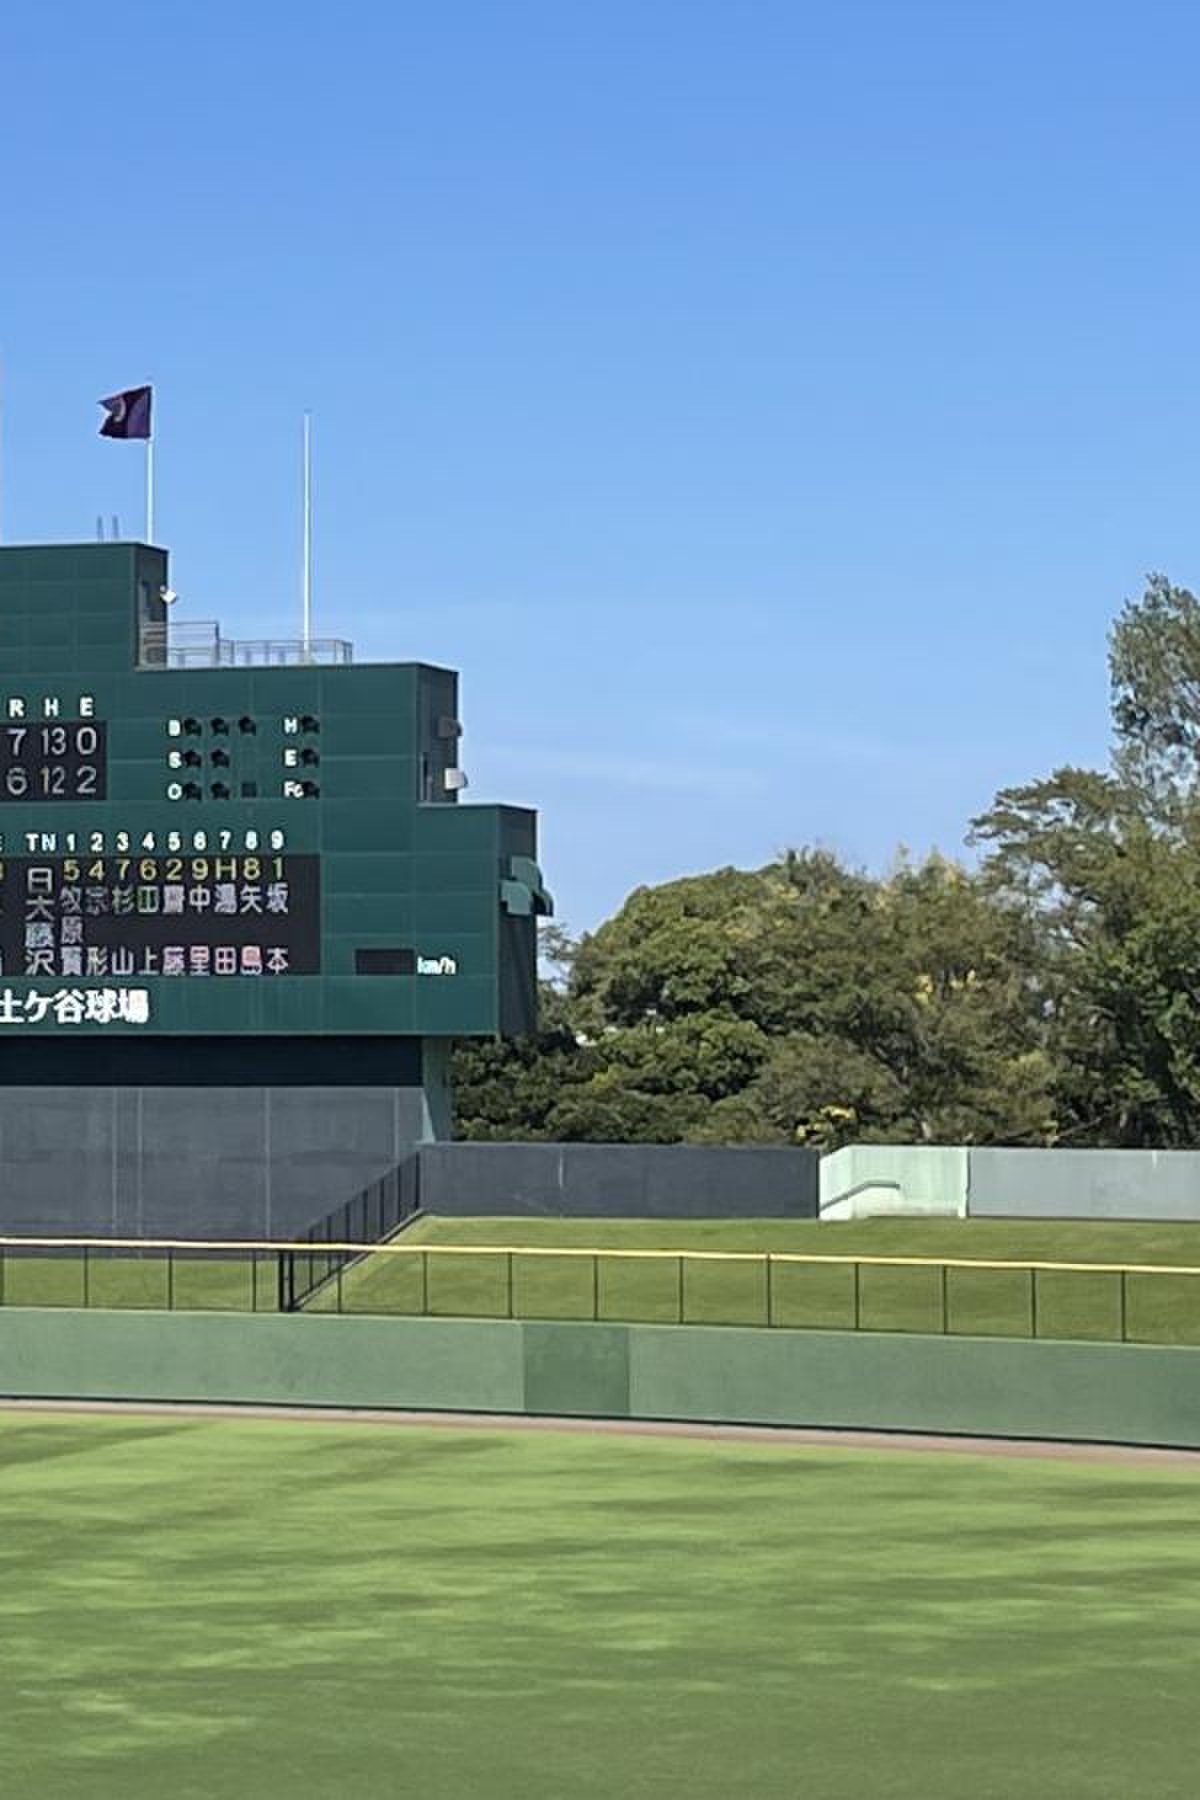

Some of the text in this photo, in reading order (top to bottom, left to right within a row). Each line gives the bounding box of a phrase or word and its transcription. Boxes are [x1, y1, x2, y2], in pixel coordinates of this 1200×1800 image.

[10, 699, 24, 717] R
[45, 698, 58, 716] H
[80, 698, 92, 716] E
[285, 718, 297, 733] H
[8, 729, 26, 755] 7
[42, 727, 66, 754] 13
[77, 727, 96, 754] 0
[169, 752, 181, 768] S
[285, 750, 296, 766] E
[7, 768, 27, 795] 6
[42, 766, 64, 794] 12
[77, 766, 96, 793] 2
[168, 784, 182, 799] O
[26, 831, 283, 852] TN 1 2 3 4 5 6 7 8 9
[64, 858, 282, 880] 5 4 7 6 2 9 H 8 1
[112, 884, 134, 976] 杉山
[137, 885, 159, 976] 田上
[189, 883, 211, 976] 中里
[240, 884, 262, 976] 矢島
[266, 882, 288, 976] 坂本
[417, 957, 455, 974] km/h
